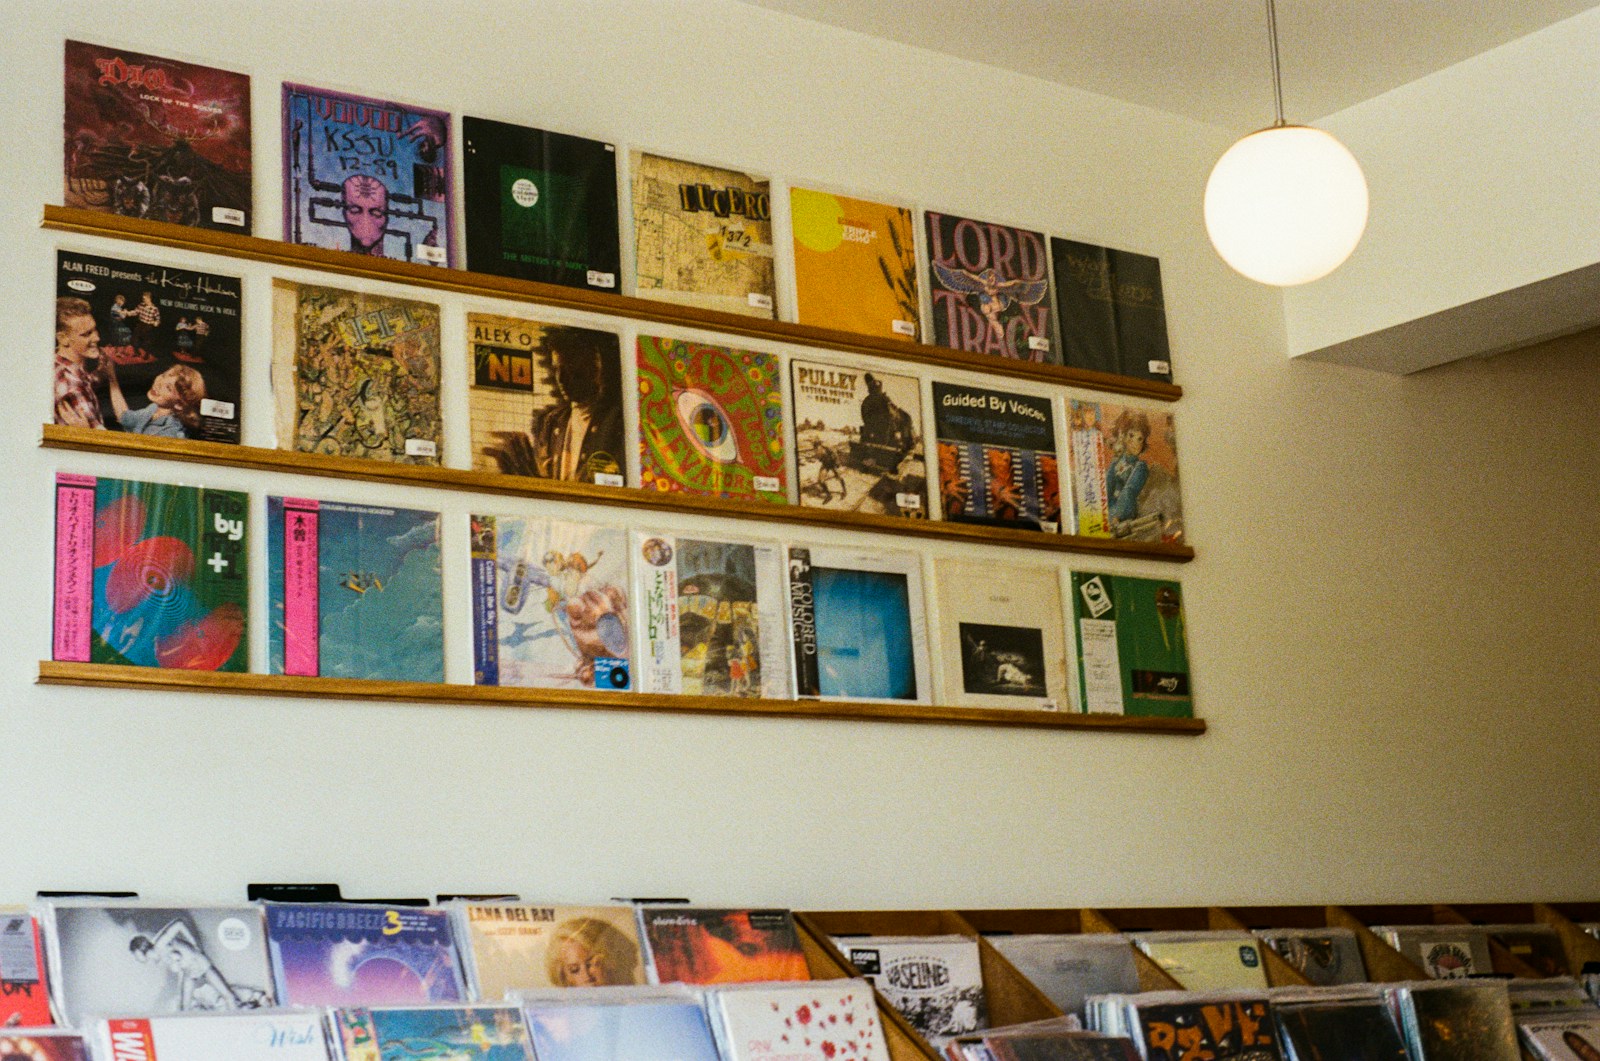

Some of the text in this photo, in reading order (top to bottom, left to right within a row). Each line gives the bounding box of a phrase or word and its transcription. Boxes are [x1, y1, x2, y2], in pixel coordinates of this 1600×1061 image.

[139, 93, 160, 103] LOCK
[175, 100, 189, 108] THE
[679, 183, 771, 221] LUCERO
[928, 212, 1046, 282] LORD
[62, 260, 83, 272] ALAN
[85, 263, 110, 276] FREED
[111, 270, 142, 282] presents
[474, 326, 511, 344] ALEX
[798, 367, 858, 391] PULLEY
[942, 394, 1047, 422] Guided By Voices
[214, 512, 244, 541] by
[801, 582, 816, 656] COLORED
[277, 910, 335, 929] PACIFIC
[382, 910, 402, 935] 3
[505, 907, 529, 922] DEL
[531, 907, 556, 923] RAY
